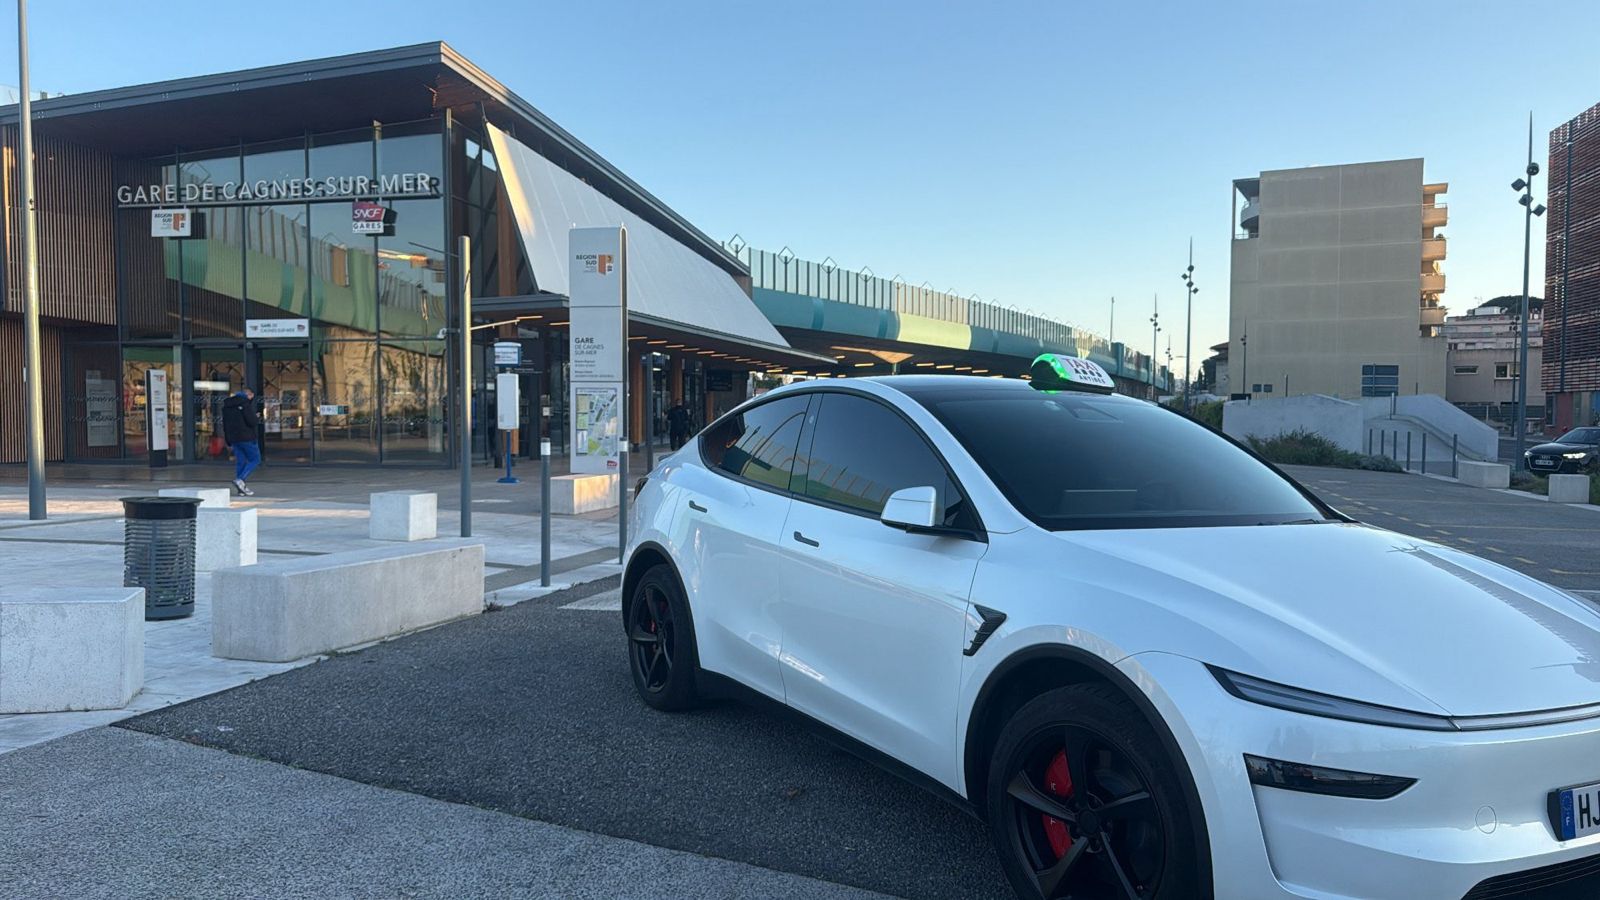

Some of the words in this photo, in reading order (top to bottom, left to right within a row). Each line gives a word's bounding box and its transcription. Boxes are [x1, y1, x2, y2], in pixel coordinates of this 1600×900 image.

[117, 184, 177, 203] GARE
[186, 182, 214, 201] DE
[223, 173, 430, 199] CAGNES-SUR-MER
[353, 208, 382, 219] SNCF
[353, 222, 382, 230] GARES
[1061, 358, 1098, 371] TAXI
[1565, 816, 1570, 827] F
